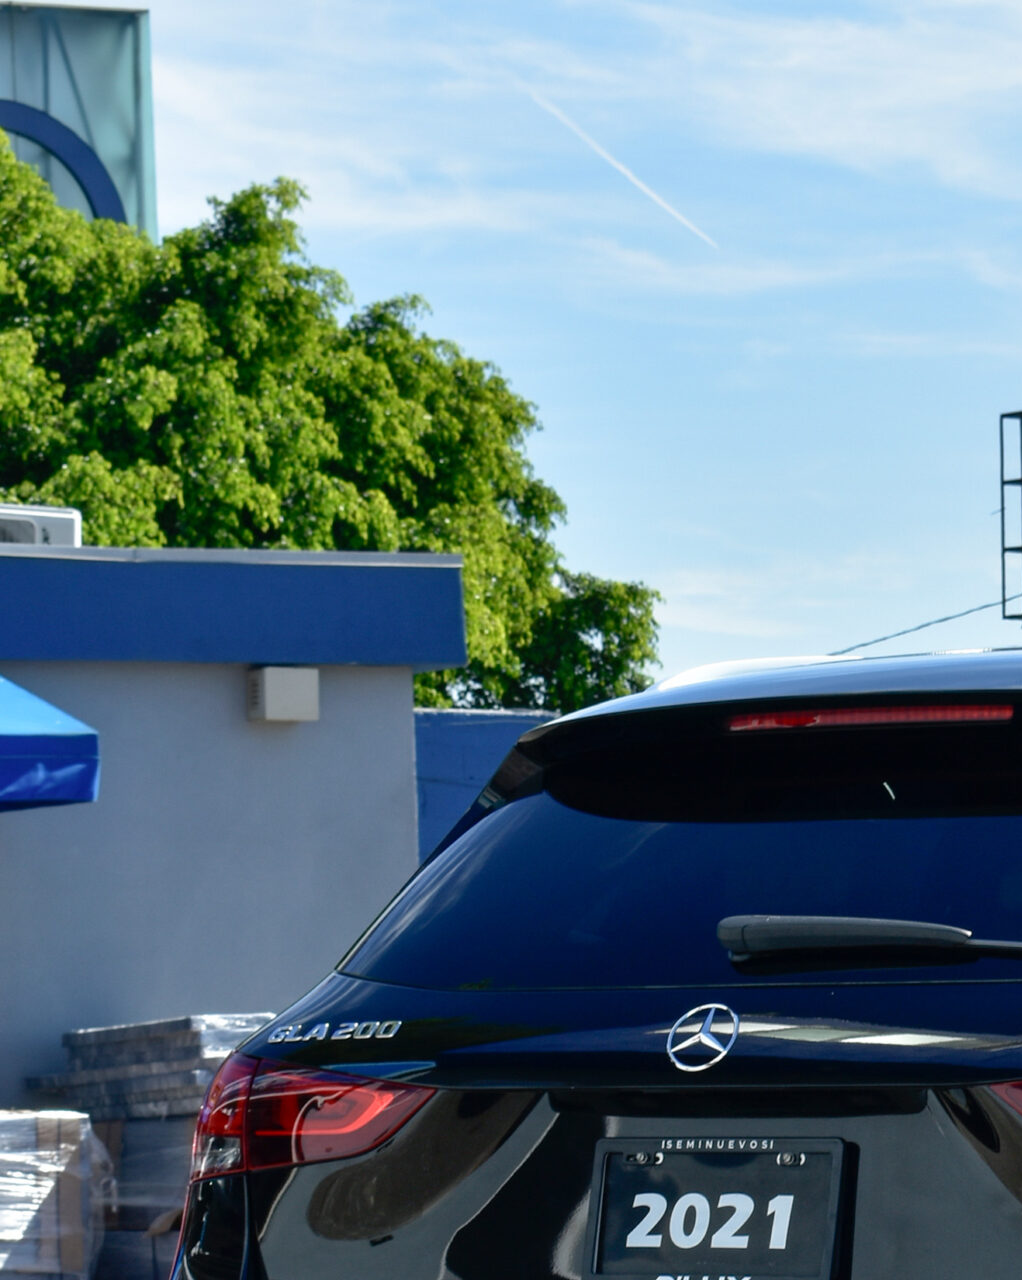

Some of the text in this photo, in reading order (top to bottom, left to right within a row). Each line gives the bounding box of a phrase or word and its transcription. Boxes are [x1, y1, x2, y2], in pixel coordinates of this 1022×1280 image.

[267, 1020, 402, 1044] GLA 200
[625, 1192, 794, 1250] 2021
